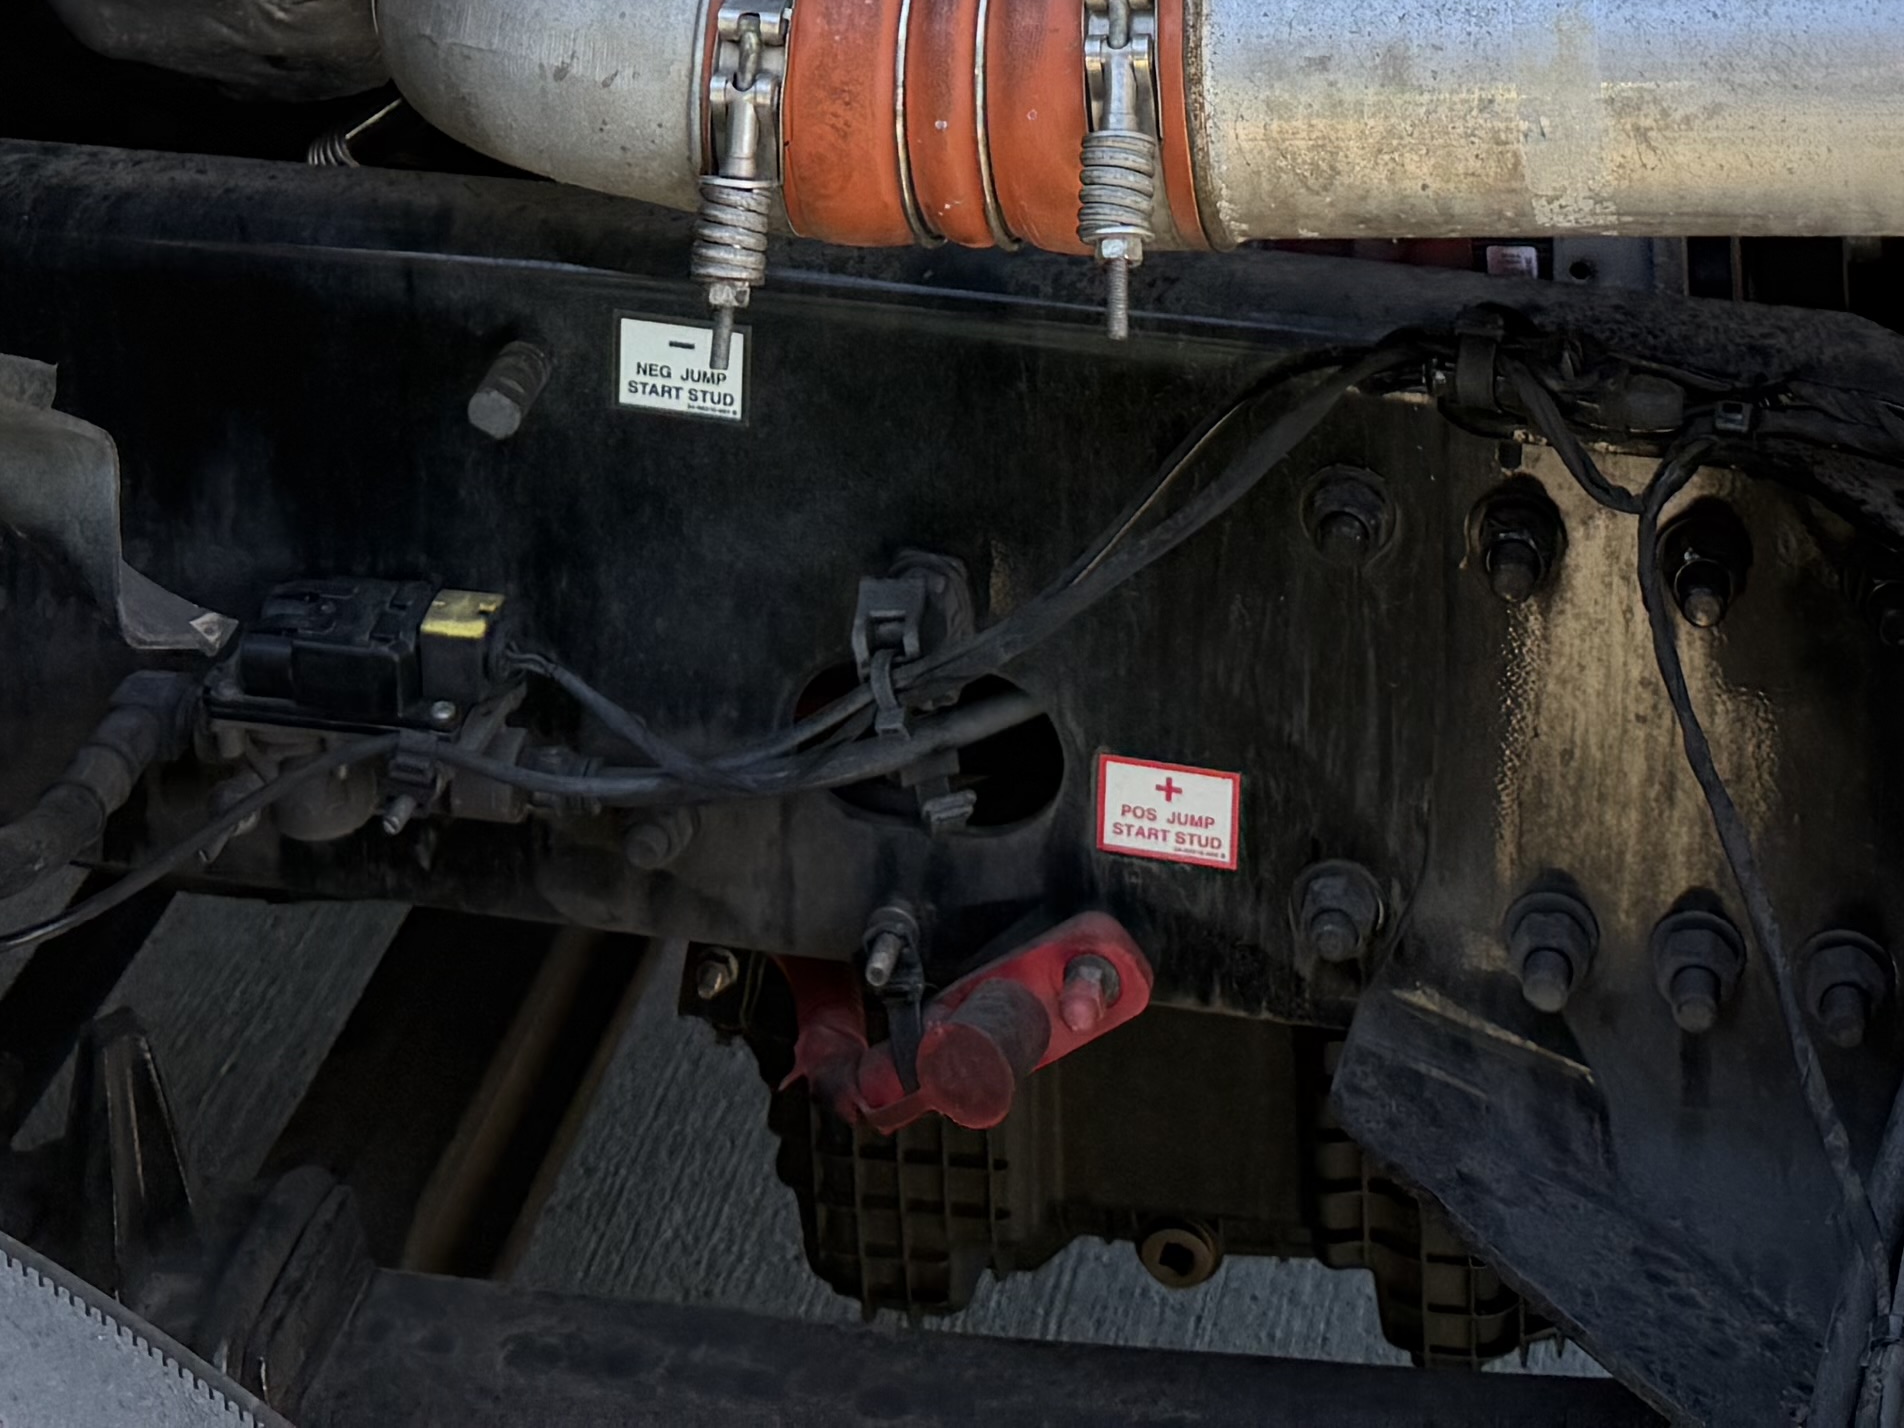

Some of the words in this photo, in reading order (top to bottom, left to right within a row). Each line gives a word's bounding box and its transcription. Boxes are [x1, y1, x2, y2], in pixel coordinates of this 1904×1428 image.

[636, 361, 672, 379] NEG
[680, 367, 727, 386] JUMP
[628, 379, 684, 400] START
[688, 388, 735, 407] STUD
[1120, 803, 1157, 822] POS
[1166, 811, 1215, 830] JUMP
[1112, 821, 1171, 843] START
[1175, 831, 1223, 850] STUD
